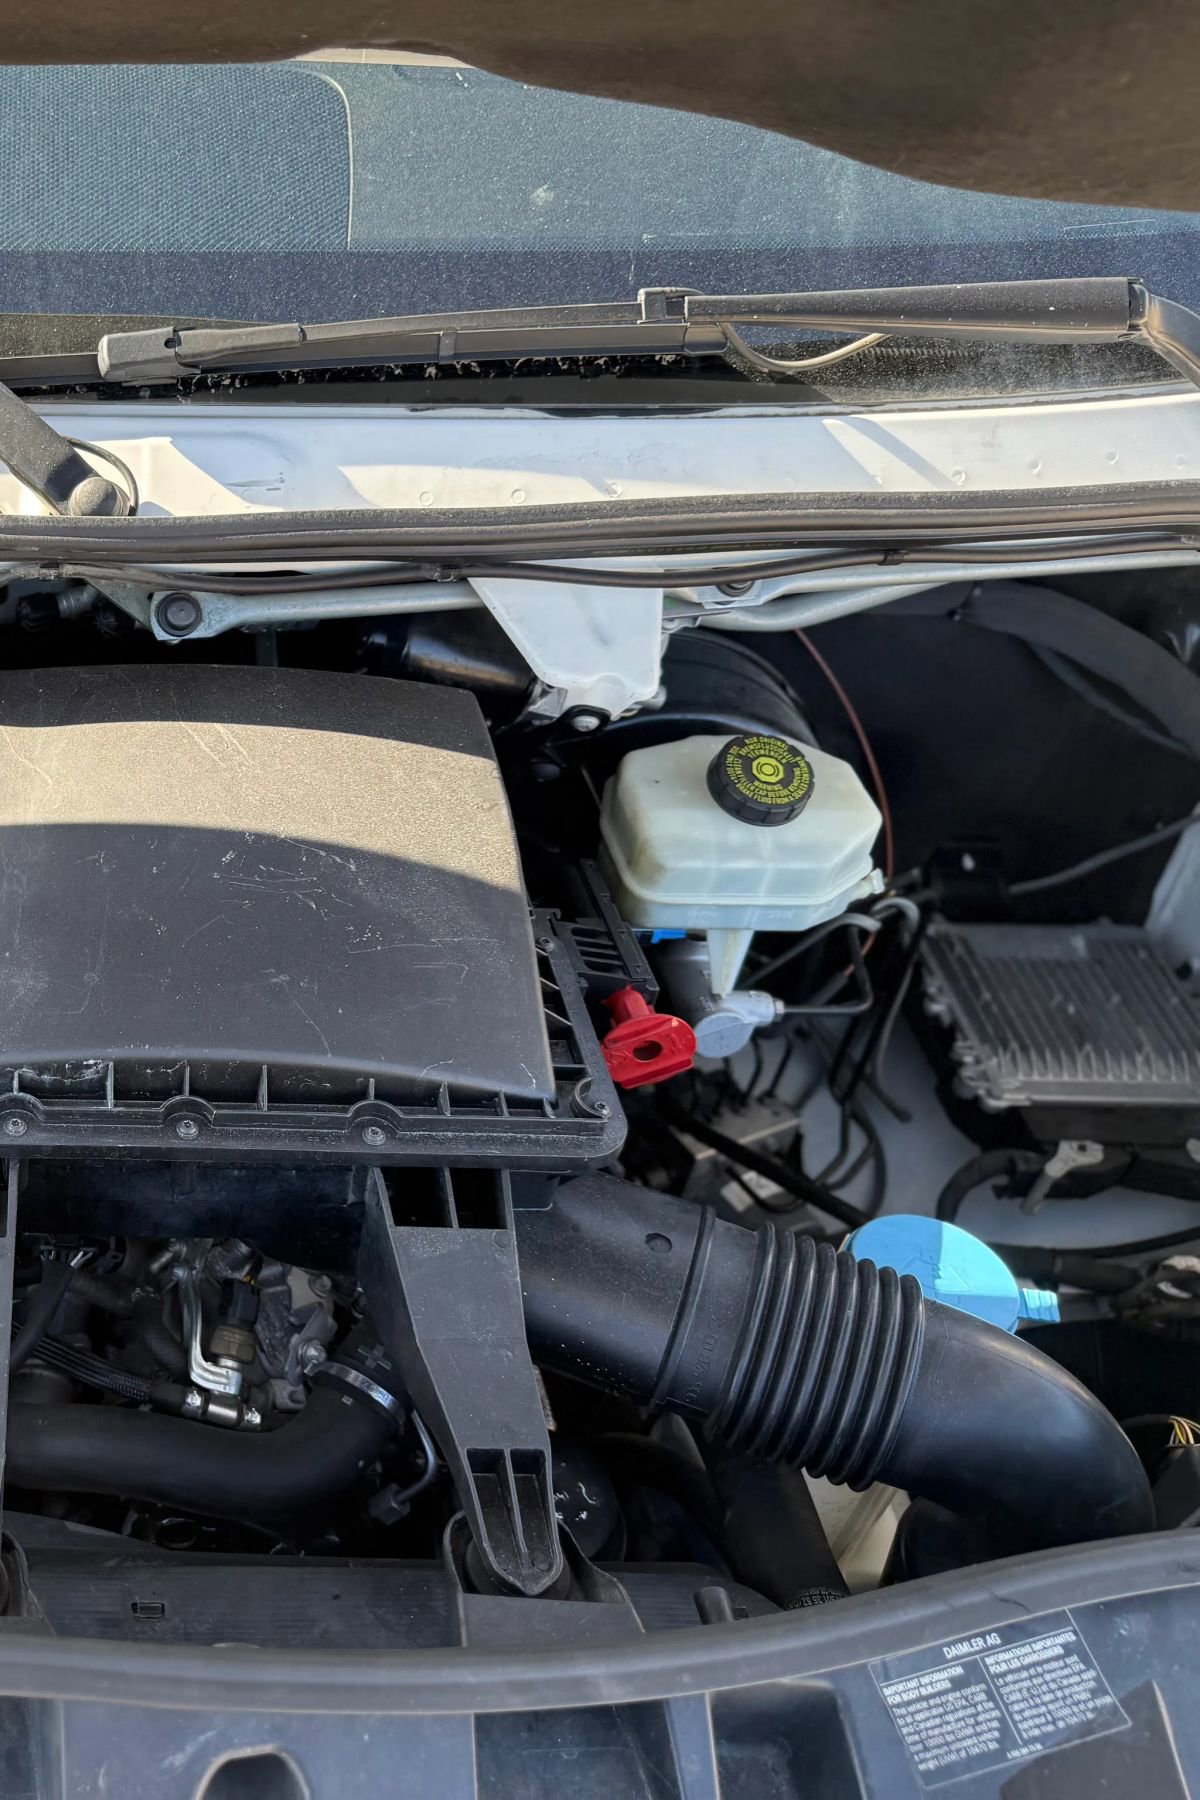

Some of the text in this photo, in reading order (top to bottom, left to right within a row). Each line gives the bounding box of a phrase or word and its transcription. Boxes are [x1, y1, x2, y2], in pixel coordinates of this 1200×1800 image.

[942, 1633, 1001, 1659] DAIMLER AG
[984, 1633, 1076, 1665] INFORMATIONS IMPORTANTES
[883, 1666, 963, 1696] IMPORTANT INFORMATION
[989, 1662, 1008, 1674] POUR
[887, 1694, 902, 1705] FOR
[901, 1689, 919, 1701] BODY
